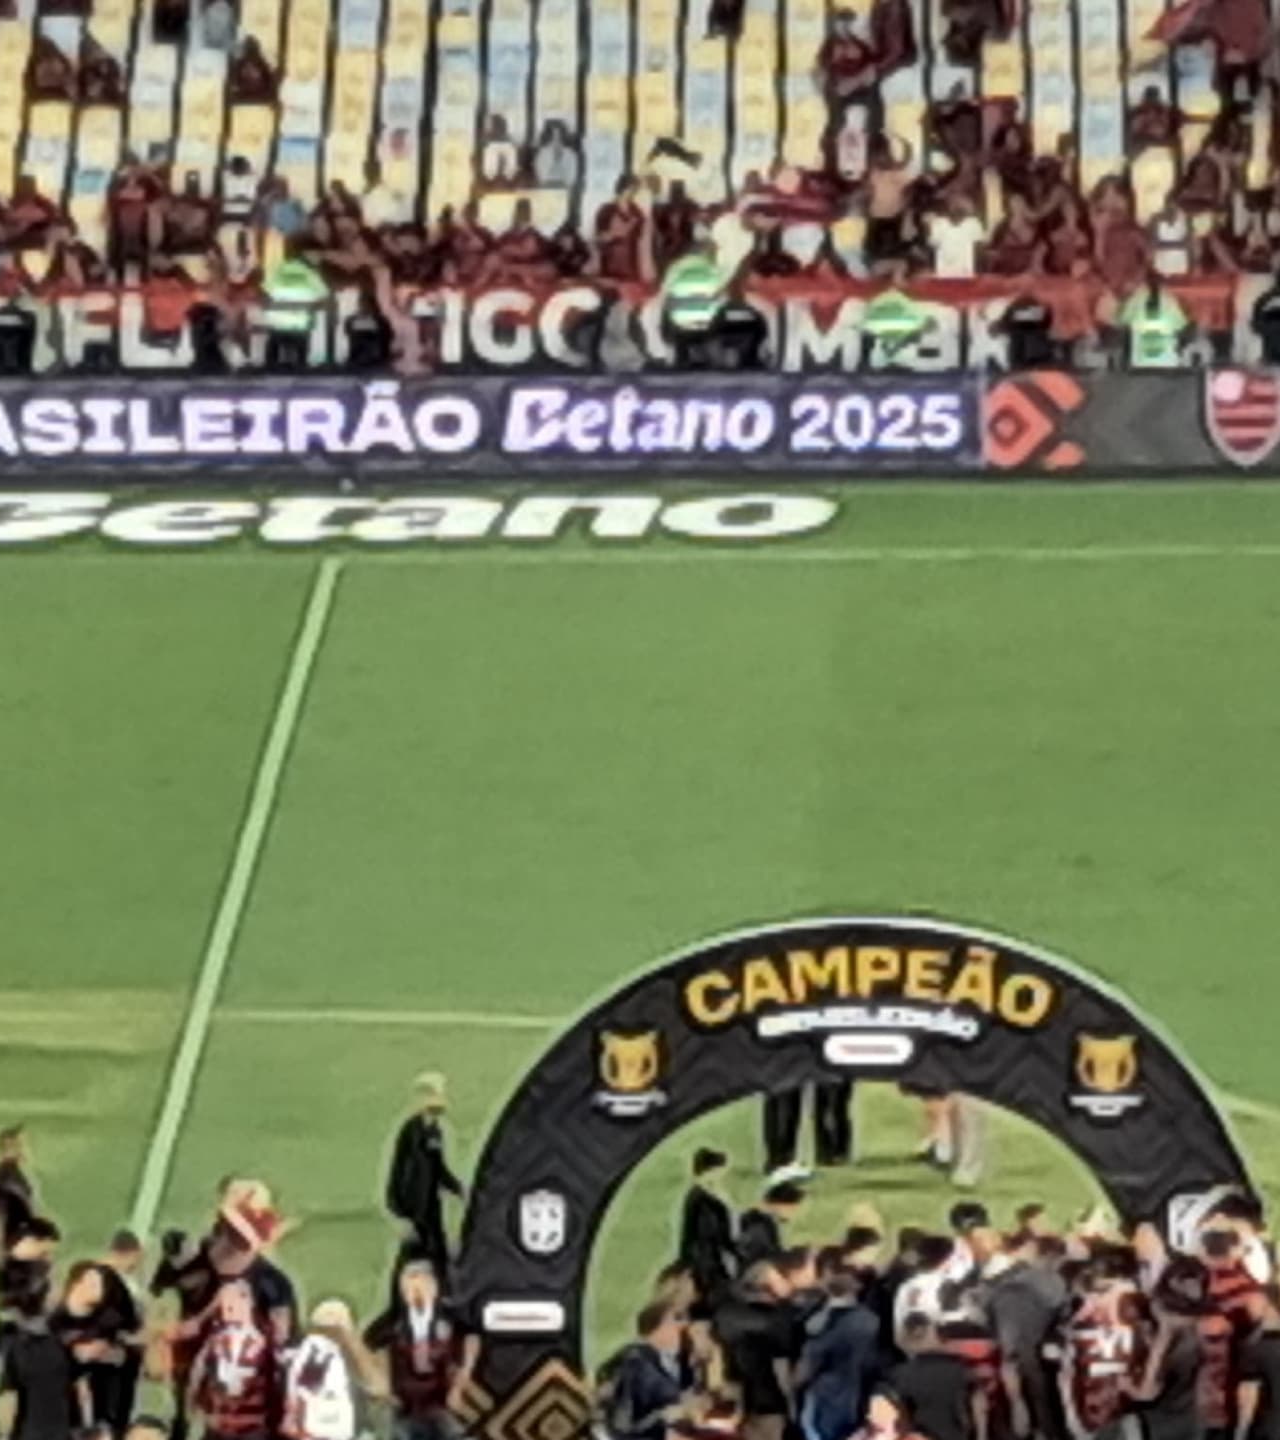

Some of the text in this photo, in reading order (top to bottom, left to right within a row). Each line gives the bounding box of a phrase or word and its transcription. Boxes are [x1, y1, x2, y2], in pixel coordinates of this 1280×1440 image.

[502, 386, 775, 453] Betano
[790, 393, 963, 452] 2025
[684, 946, 1053, 1028] CAMPEÃO
